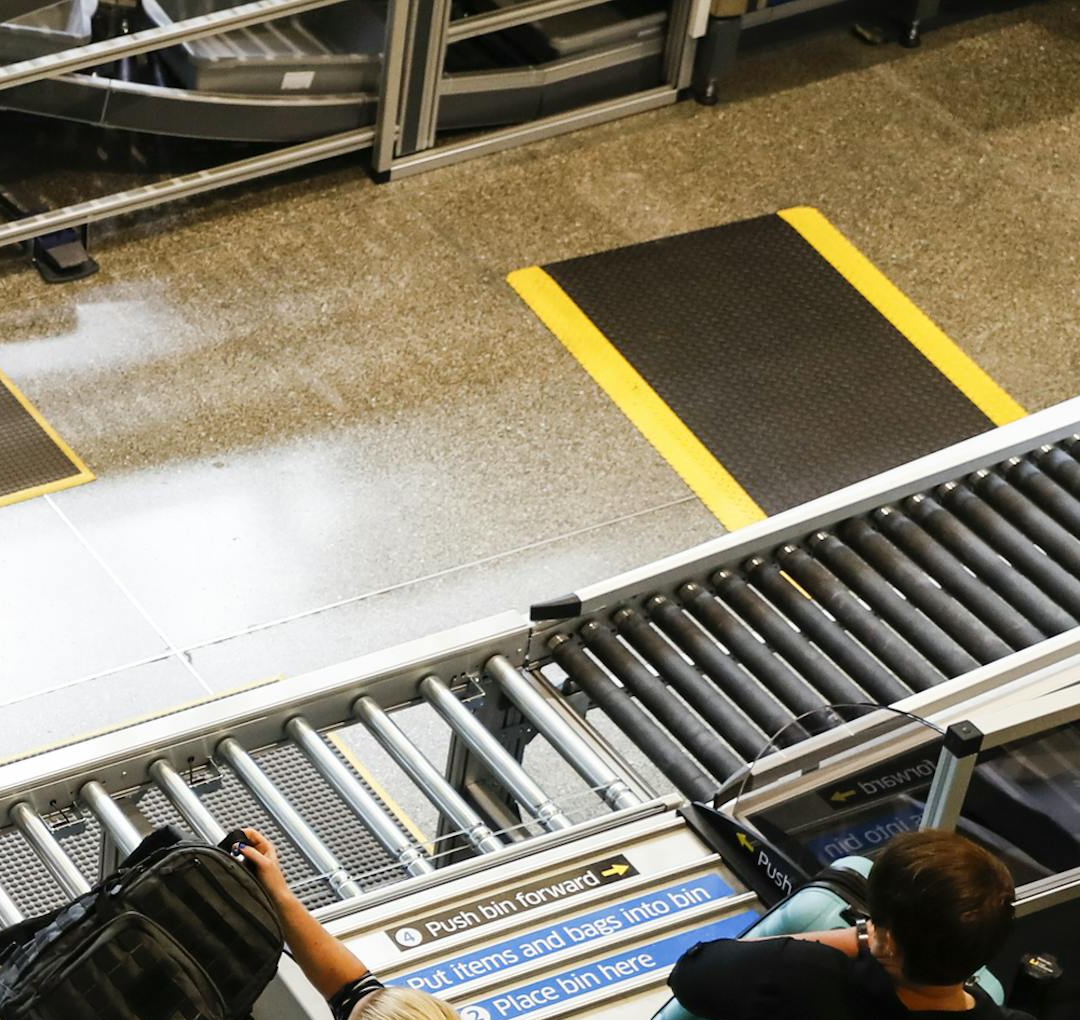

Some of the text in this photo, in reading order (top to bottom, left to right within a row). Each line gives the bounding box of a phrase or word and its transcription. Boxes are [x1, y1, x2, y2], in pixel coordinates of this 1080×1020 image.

[426, 907, 479, 938] Push
[478, 892, 517, 918] bin
[515, 870, 599, 911] forward
[758, 850, 793, 897] Push
[450, 949, 518, 980] items
[519, 930, 566, 959] and
[570, 915, 623, 938] bags
[622, 900, 671, 924] into
[670, 884, 711, 911] bin
[493, 984, 558, 1017] Place
[560, 970, 601, 993] bin
[597, 952, 656, 981] here
